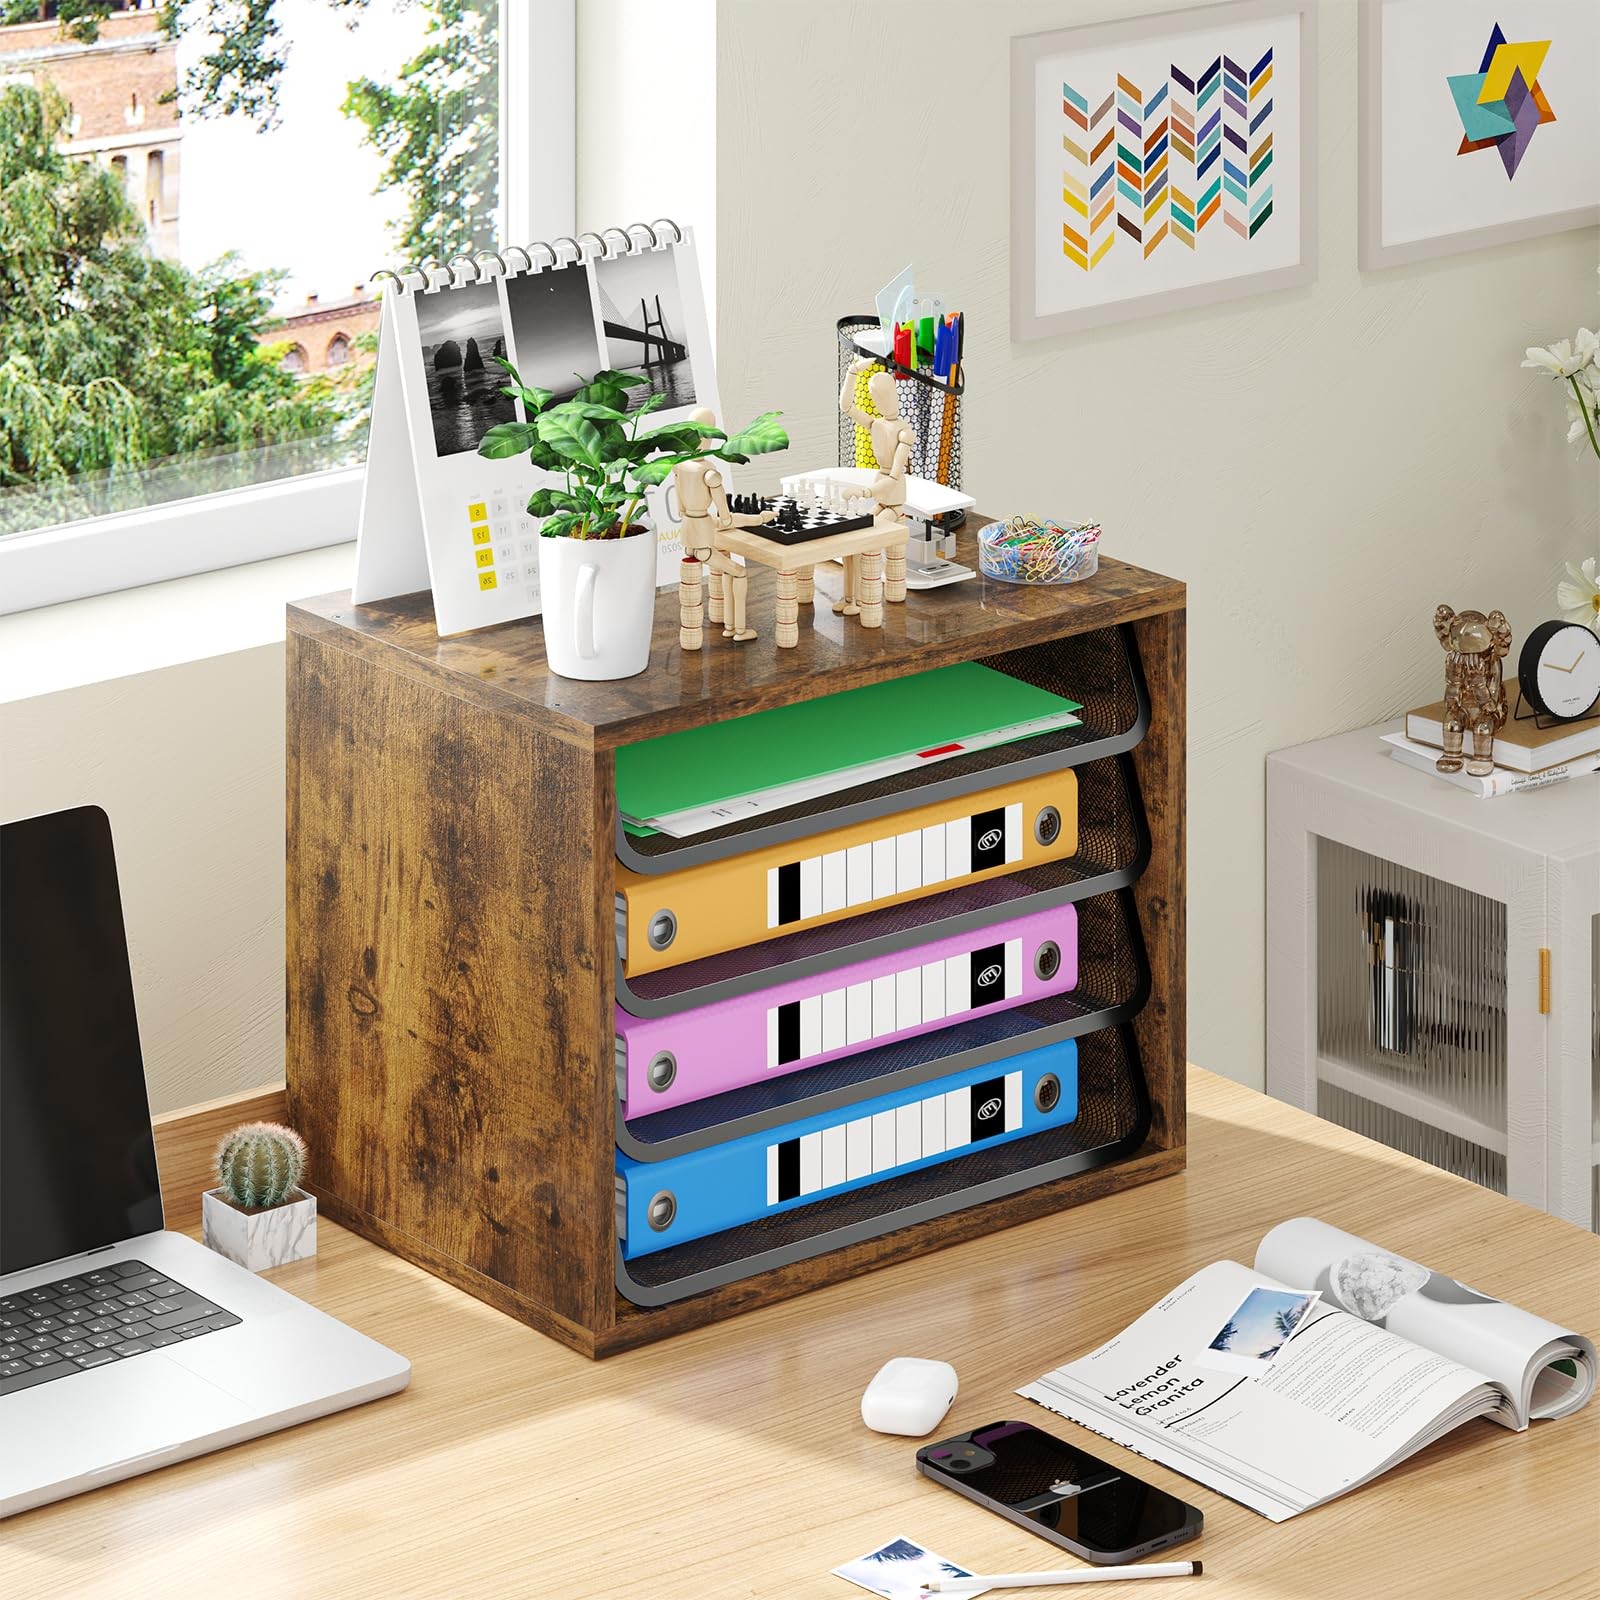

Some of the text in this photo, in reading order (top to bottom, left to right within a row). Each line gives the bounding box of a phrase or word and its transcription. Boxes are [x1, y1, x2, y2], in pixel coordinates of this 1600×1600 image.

[1103, 1354, 1183, 1402] Lavender
[1118, 1377, 1181, 1410] Lemon
[1135, 1378, 1205, 1416] Granita
